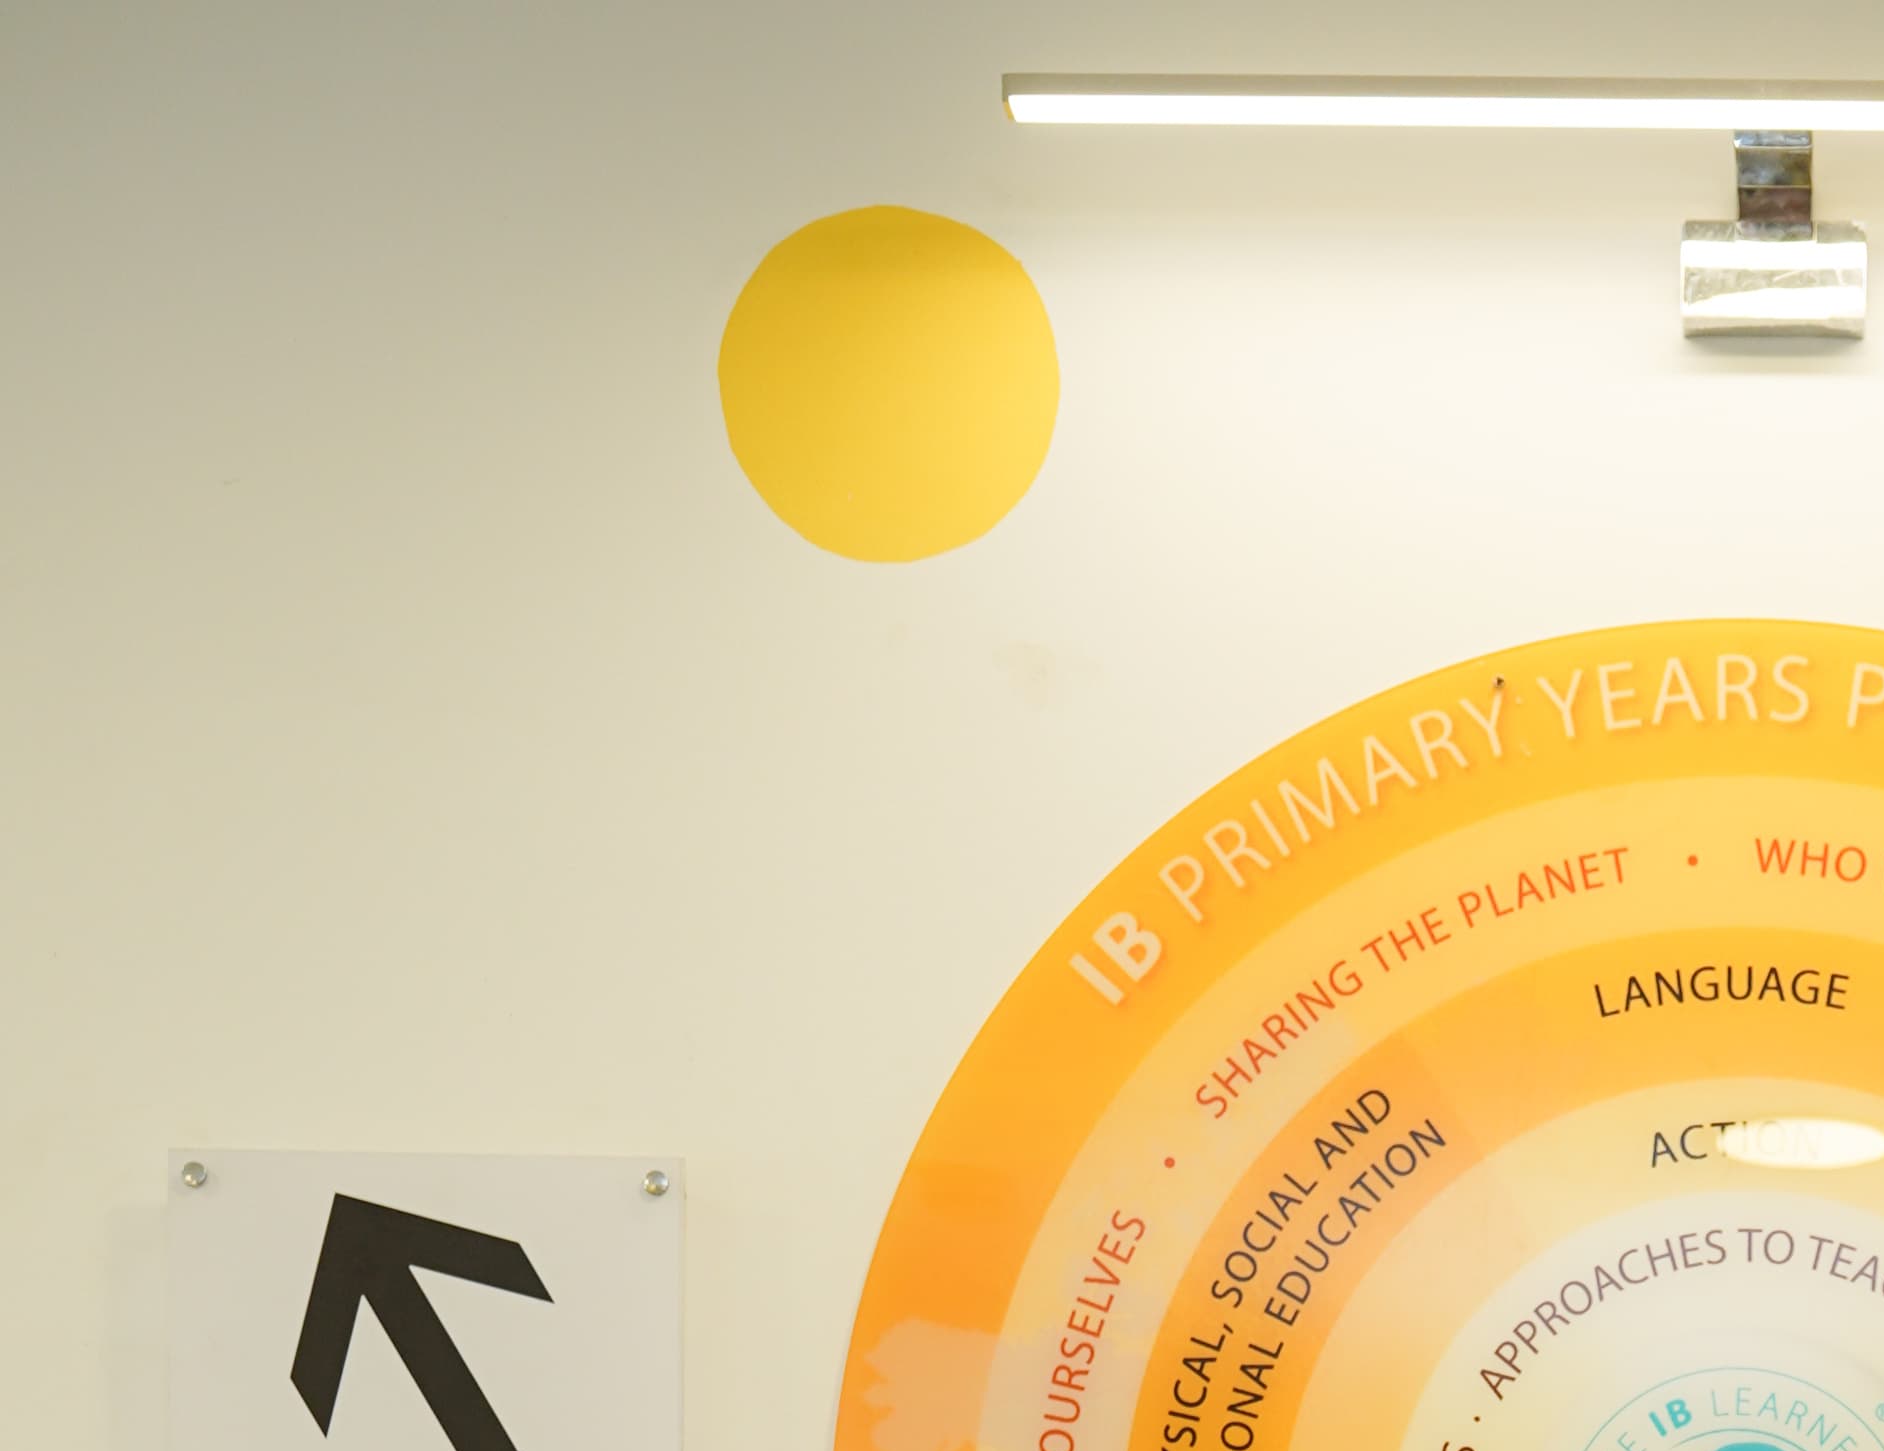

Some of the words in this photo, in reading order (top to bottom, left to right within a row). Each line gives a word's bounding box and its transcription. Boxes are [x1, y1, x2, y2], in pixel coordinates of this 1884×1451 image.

[1068, 910, 1165, 1008] IB
[1159, 690, 1508, 924] PRIMARY
[1536, 652, 1811, 740] YEARS
[1753, 836, 1868, 883] WHO
[1195, 959, 1366, 1120] SHARING
[1360, 907, 1451, 976] THE
[1456, 846, 1630, 930] PLANET
[1594, 964, 1851, 1019] LANGUAGE
[1210, 1171, 1318, 1309] SOCIAL
[1312, 1086, 1392, 1178] AND
[1264, 1118, 1447, 1327] EDUCATION
[1479, 1228, 1727, 1401] APPROACHES
[1737, 1227, 1796, 1265] TO
[1648, 1397, 1693, 1438] IB
